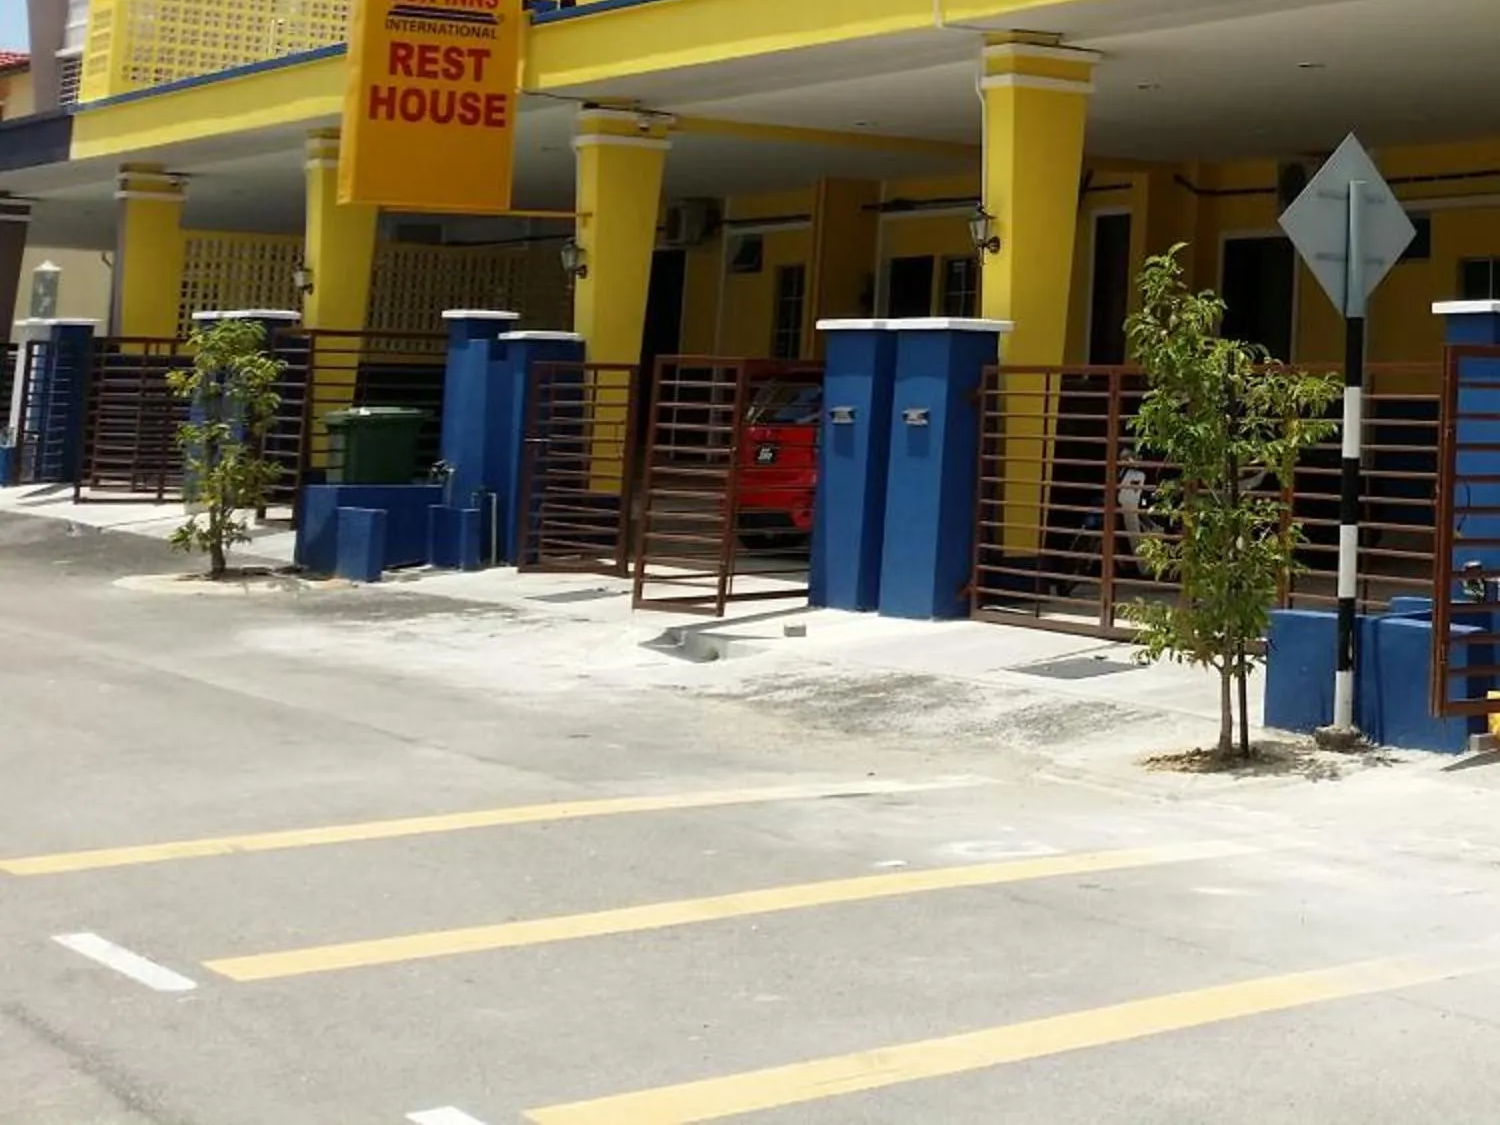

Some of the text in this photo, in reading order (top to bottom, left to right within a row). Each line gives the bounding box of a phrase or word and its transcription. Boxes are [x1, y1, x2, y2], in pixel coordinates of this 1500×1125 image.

[385, 18, 498, 40] INTERNATIONAL
[388, 40, 492, 83] REST
[368, 84, 508, 128] HOUSE
